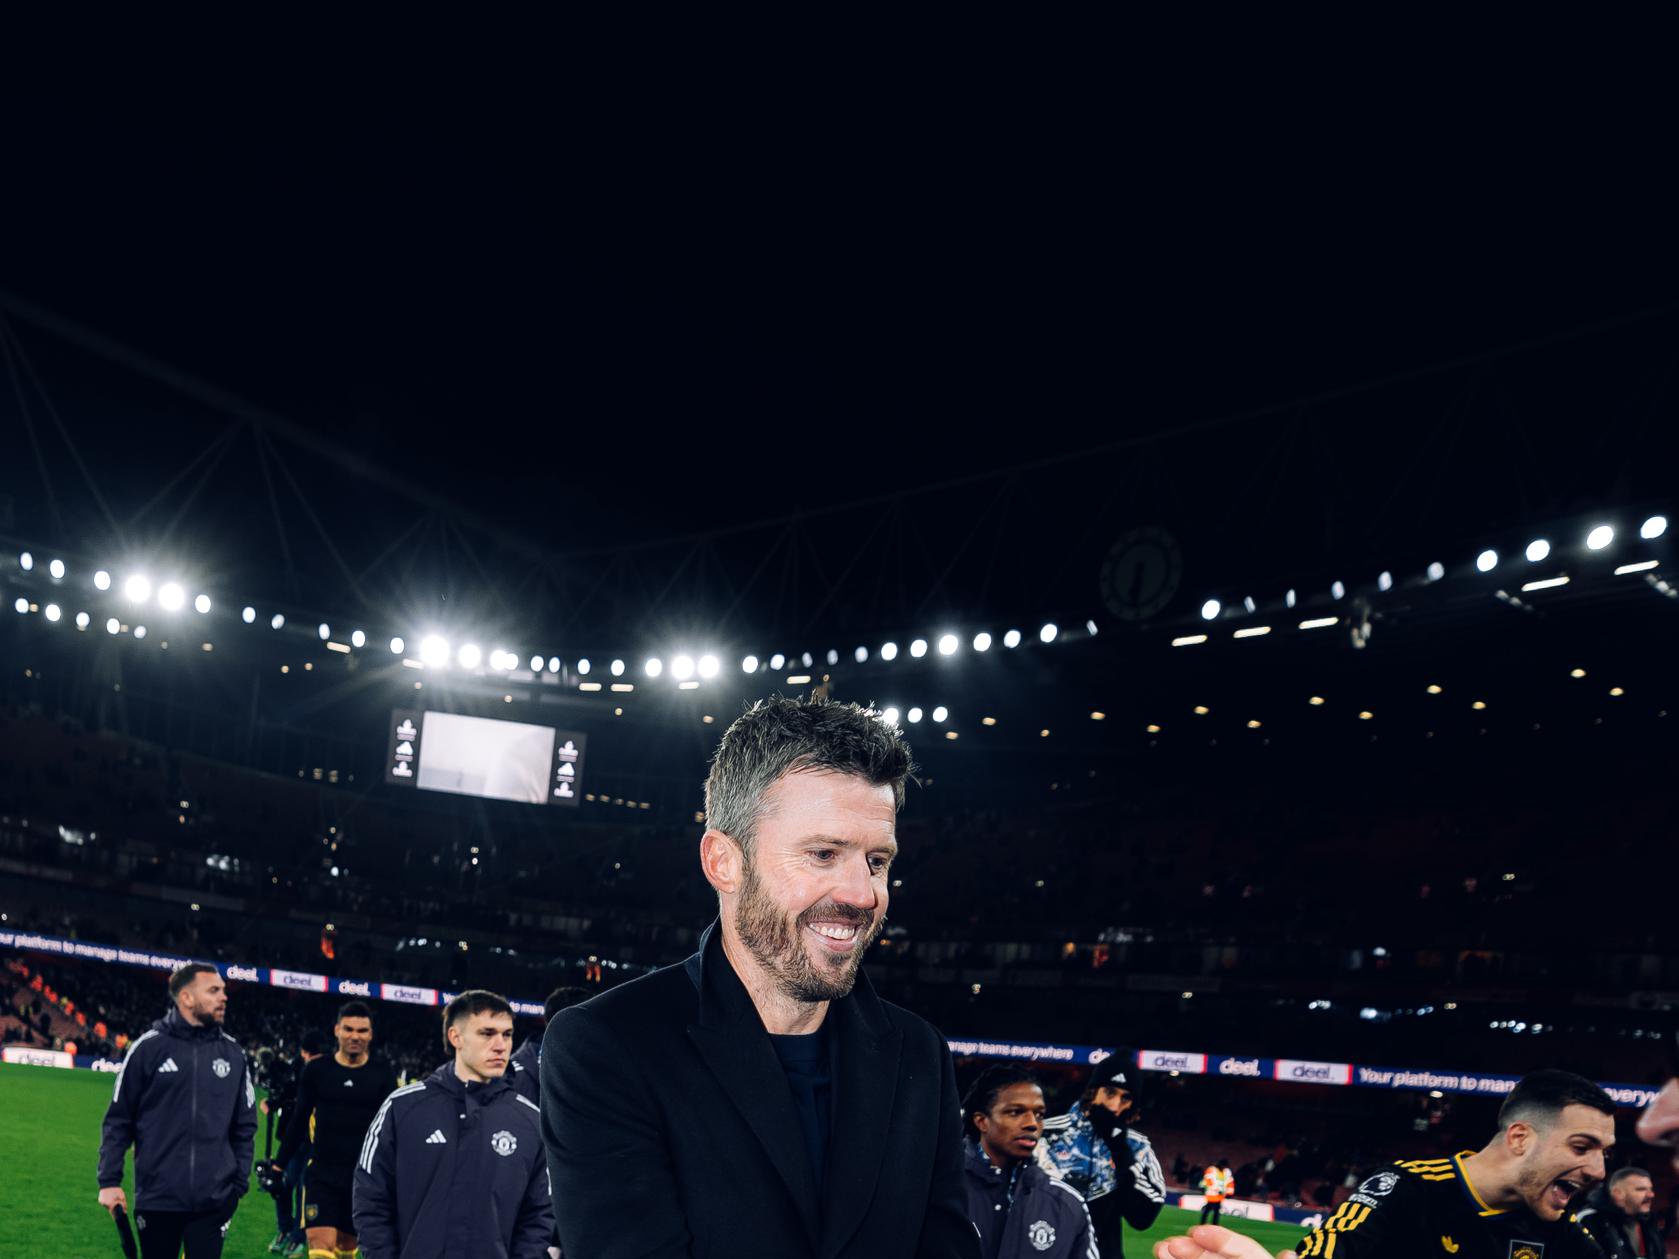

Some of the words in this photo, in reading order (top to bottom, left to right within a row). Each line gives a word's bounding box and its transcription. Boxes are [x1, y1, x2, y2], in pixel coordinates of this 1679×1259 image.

[15, 933, 62, 951] platform
[63, 941, 75, 954] to
[75, 944, 118, 962] manage
[118, 950, 150, 966] teams
[947, 1040, 978, 1056] anage
[979, 1041, 1010, 1056] teams
[1010, 1045, 1074, 1061] everywhere
[1359, 1067, 1394, 1085] Your
[1392, 1071, 1459, 1089] platform
[1459, 1075, 1478, 1091] to
[1478, 1078, 1518, 1094] man
